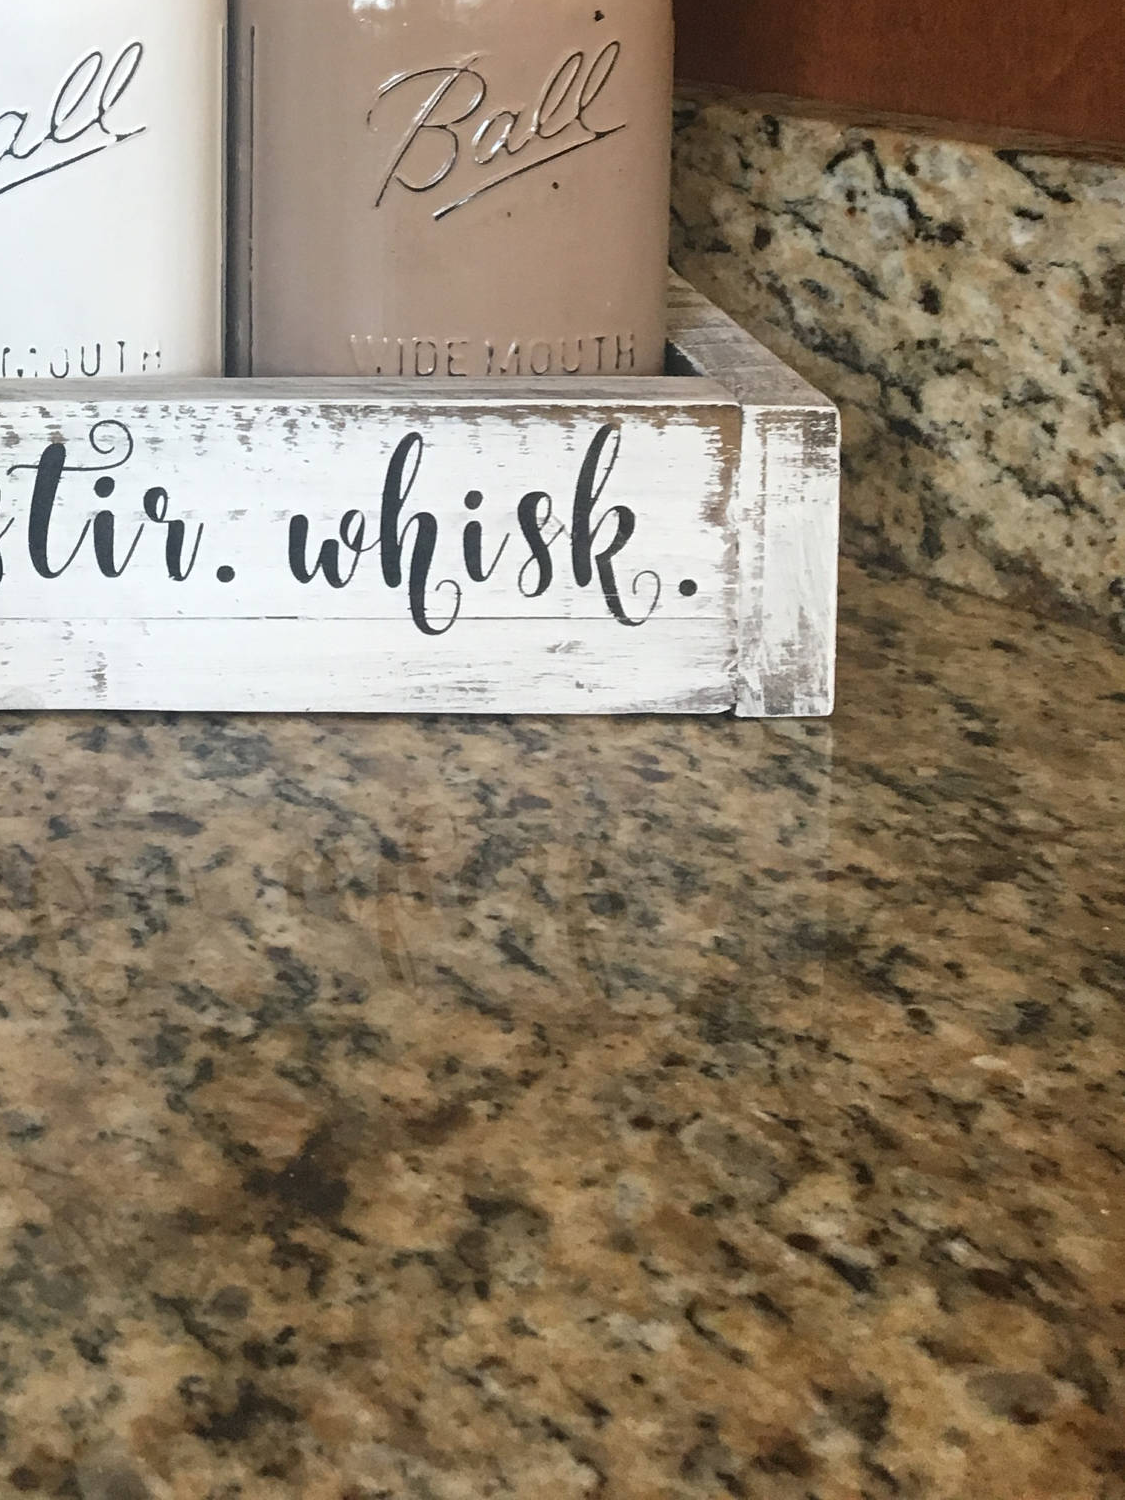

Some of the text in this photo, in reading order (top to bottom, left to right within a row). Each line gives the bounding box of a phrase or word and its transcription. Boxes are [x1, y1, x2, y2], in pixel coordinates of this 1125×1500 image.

[366, 39, 627, 221] Ball
[484, 333, 637, 377] MOUTH
[288, 422, 699, 636] whisk.
